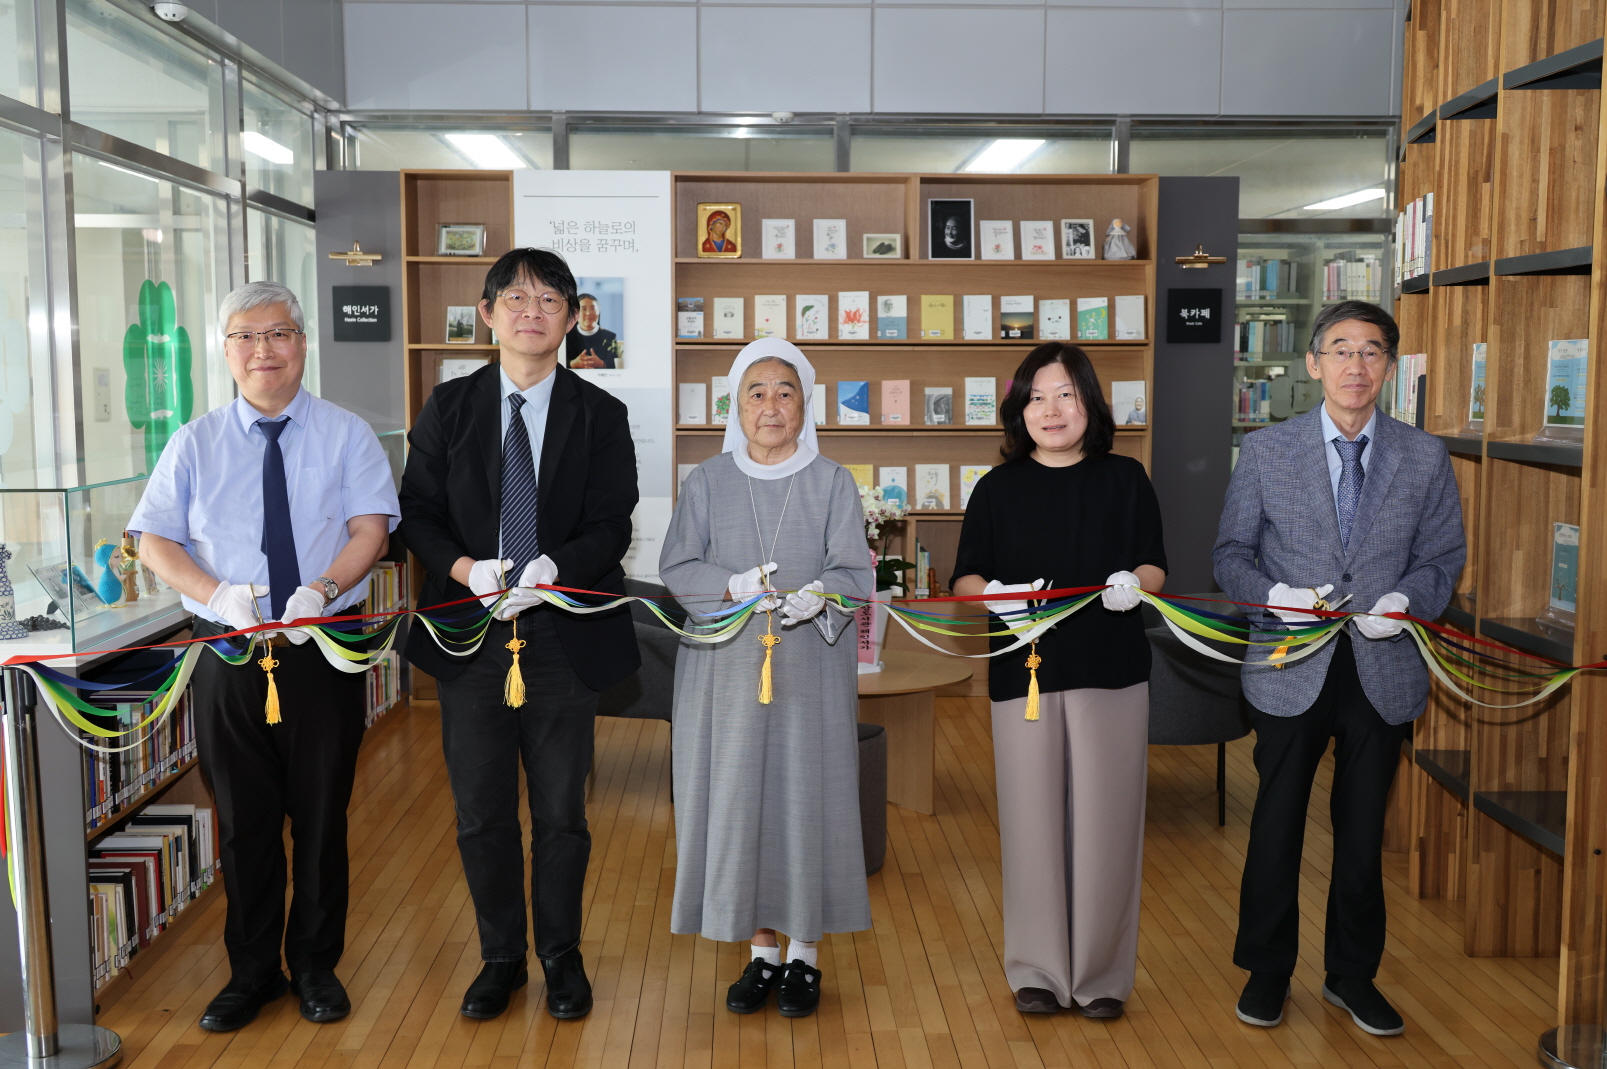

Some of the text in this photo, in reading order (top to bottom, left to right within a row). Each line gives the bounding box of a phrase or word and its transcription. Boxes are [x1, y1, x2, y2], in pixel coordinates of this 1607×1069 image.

[583, 220, 636, 235] 하늘로의
[552, 238, 639, 253] 비상을 꿈꾸며,
[342, 304, 379, 315] 해인서가
[1180, 308, 1210, 319] 북카페
[860, 628, 872, 651] 해인서가
